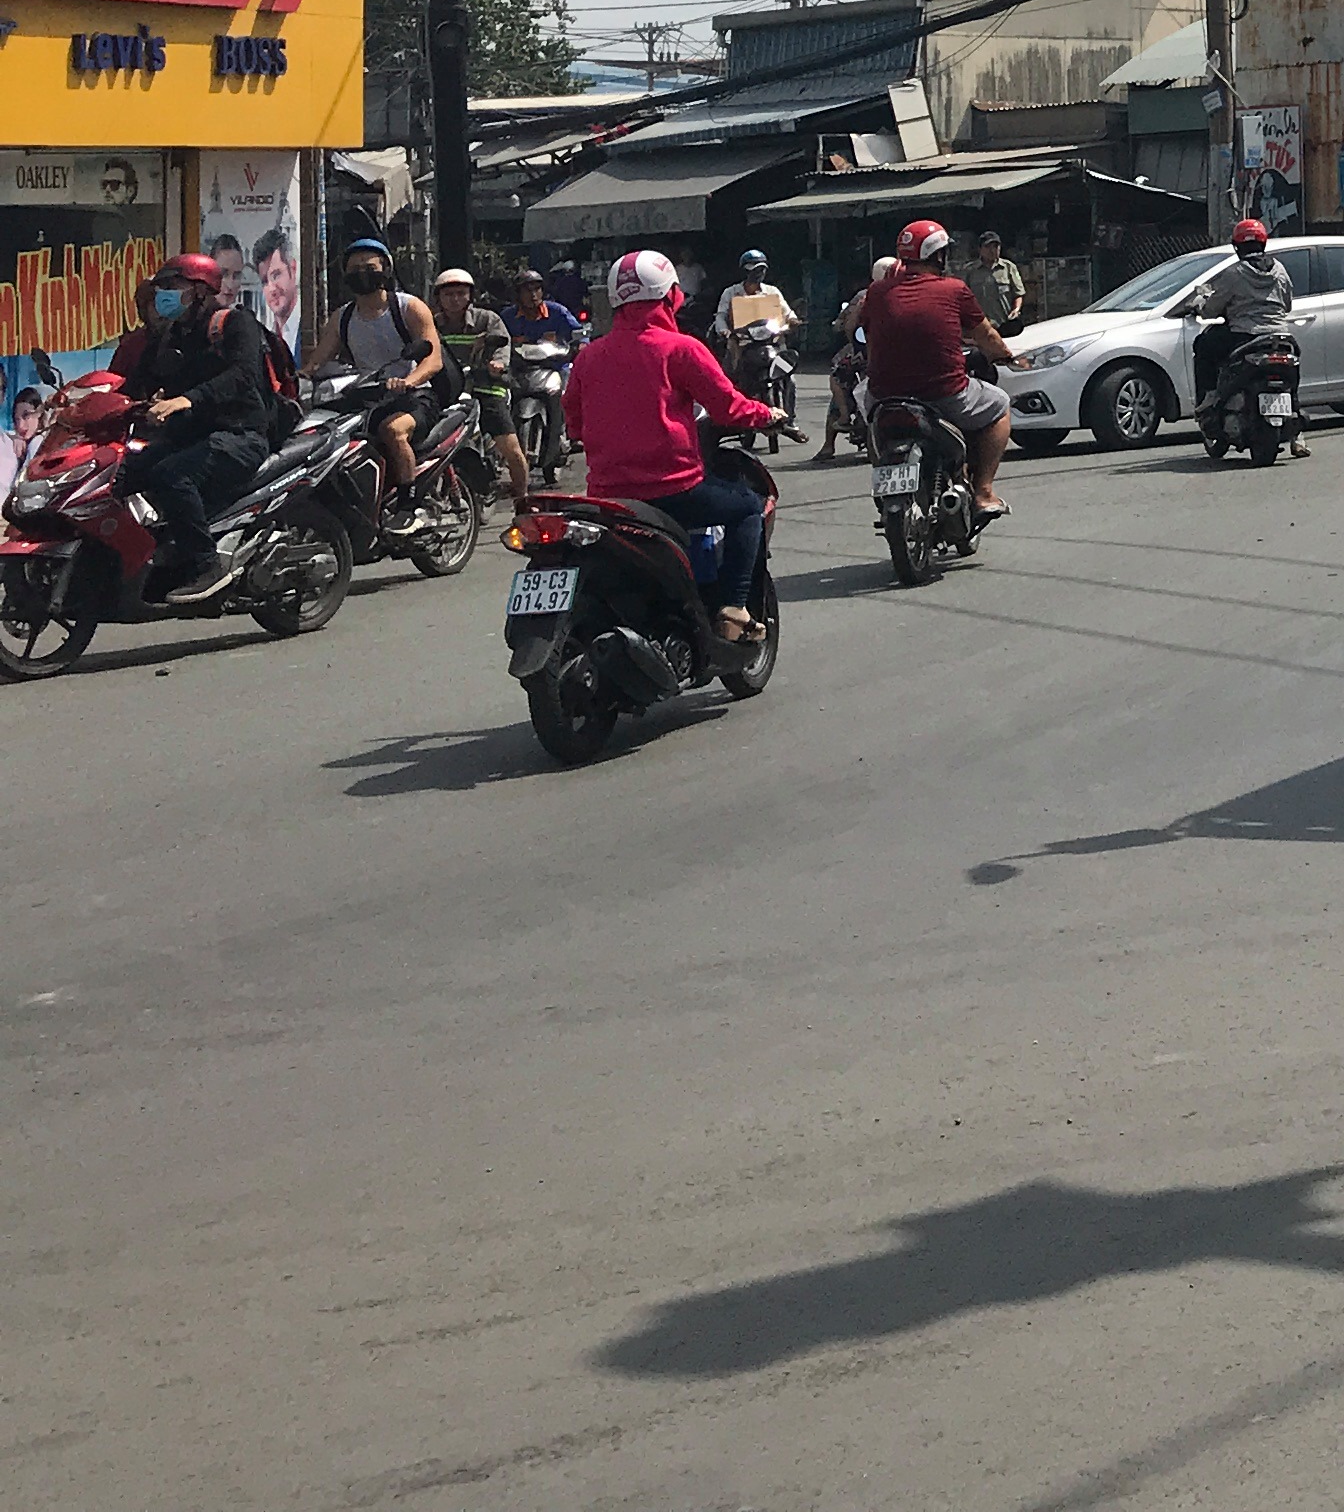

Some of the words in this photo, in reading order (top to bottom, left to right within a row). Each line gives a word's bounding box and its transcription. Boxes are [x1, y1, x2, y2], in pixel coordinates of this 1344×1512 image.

[214, 35, 287, 75] BOSS
[16, 165, 70, 189] OAKLEY
[522, 571, 568, 592] 59-C3
[511, 590, 570, 613] 014.97
